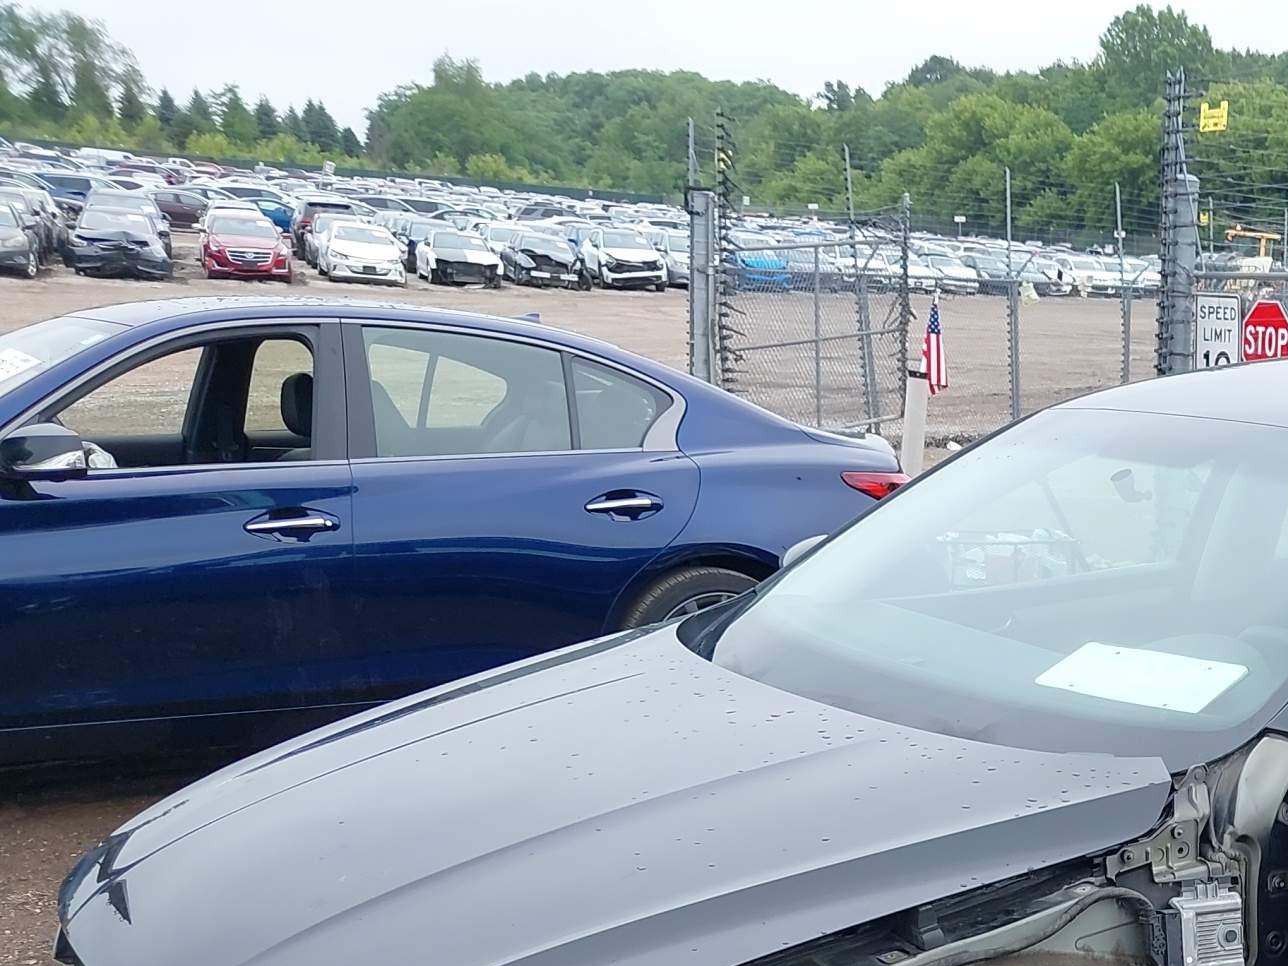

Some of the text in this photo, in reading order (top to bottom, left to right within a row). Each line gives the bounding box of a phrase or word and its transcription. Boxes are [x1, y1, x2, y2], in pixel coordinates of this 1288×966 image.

[1200, 304, 1237, 321] SPEED
[1203, 327, 1233, 344] LIMIT
[1244, 325, 1288, 359] STOP
